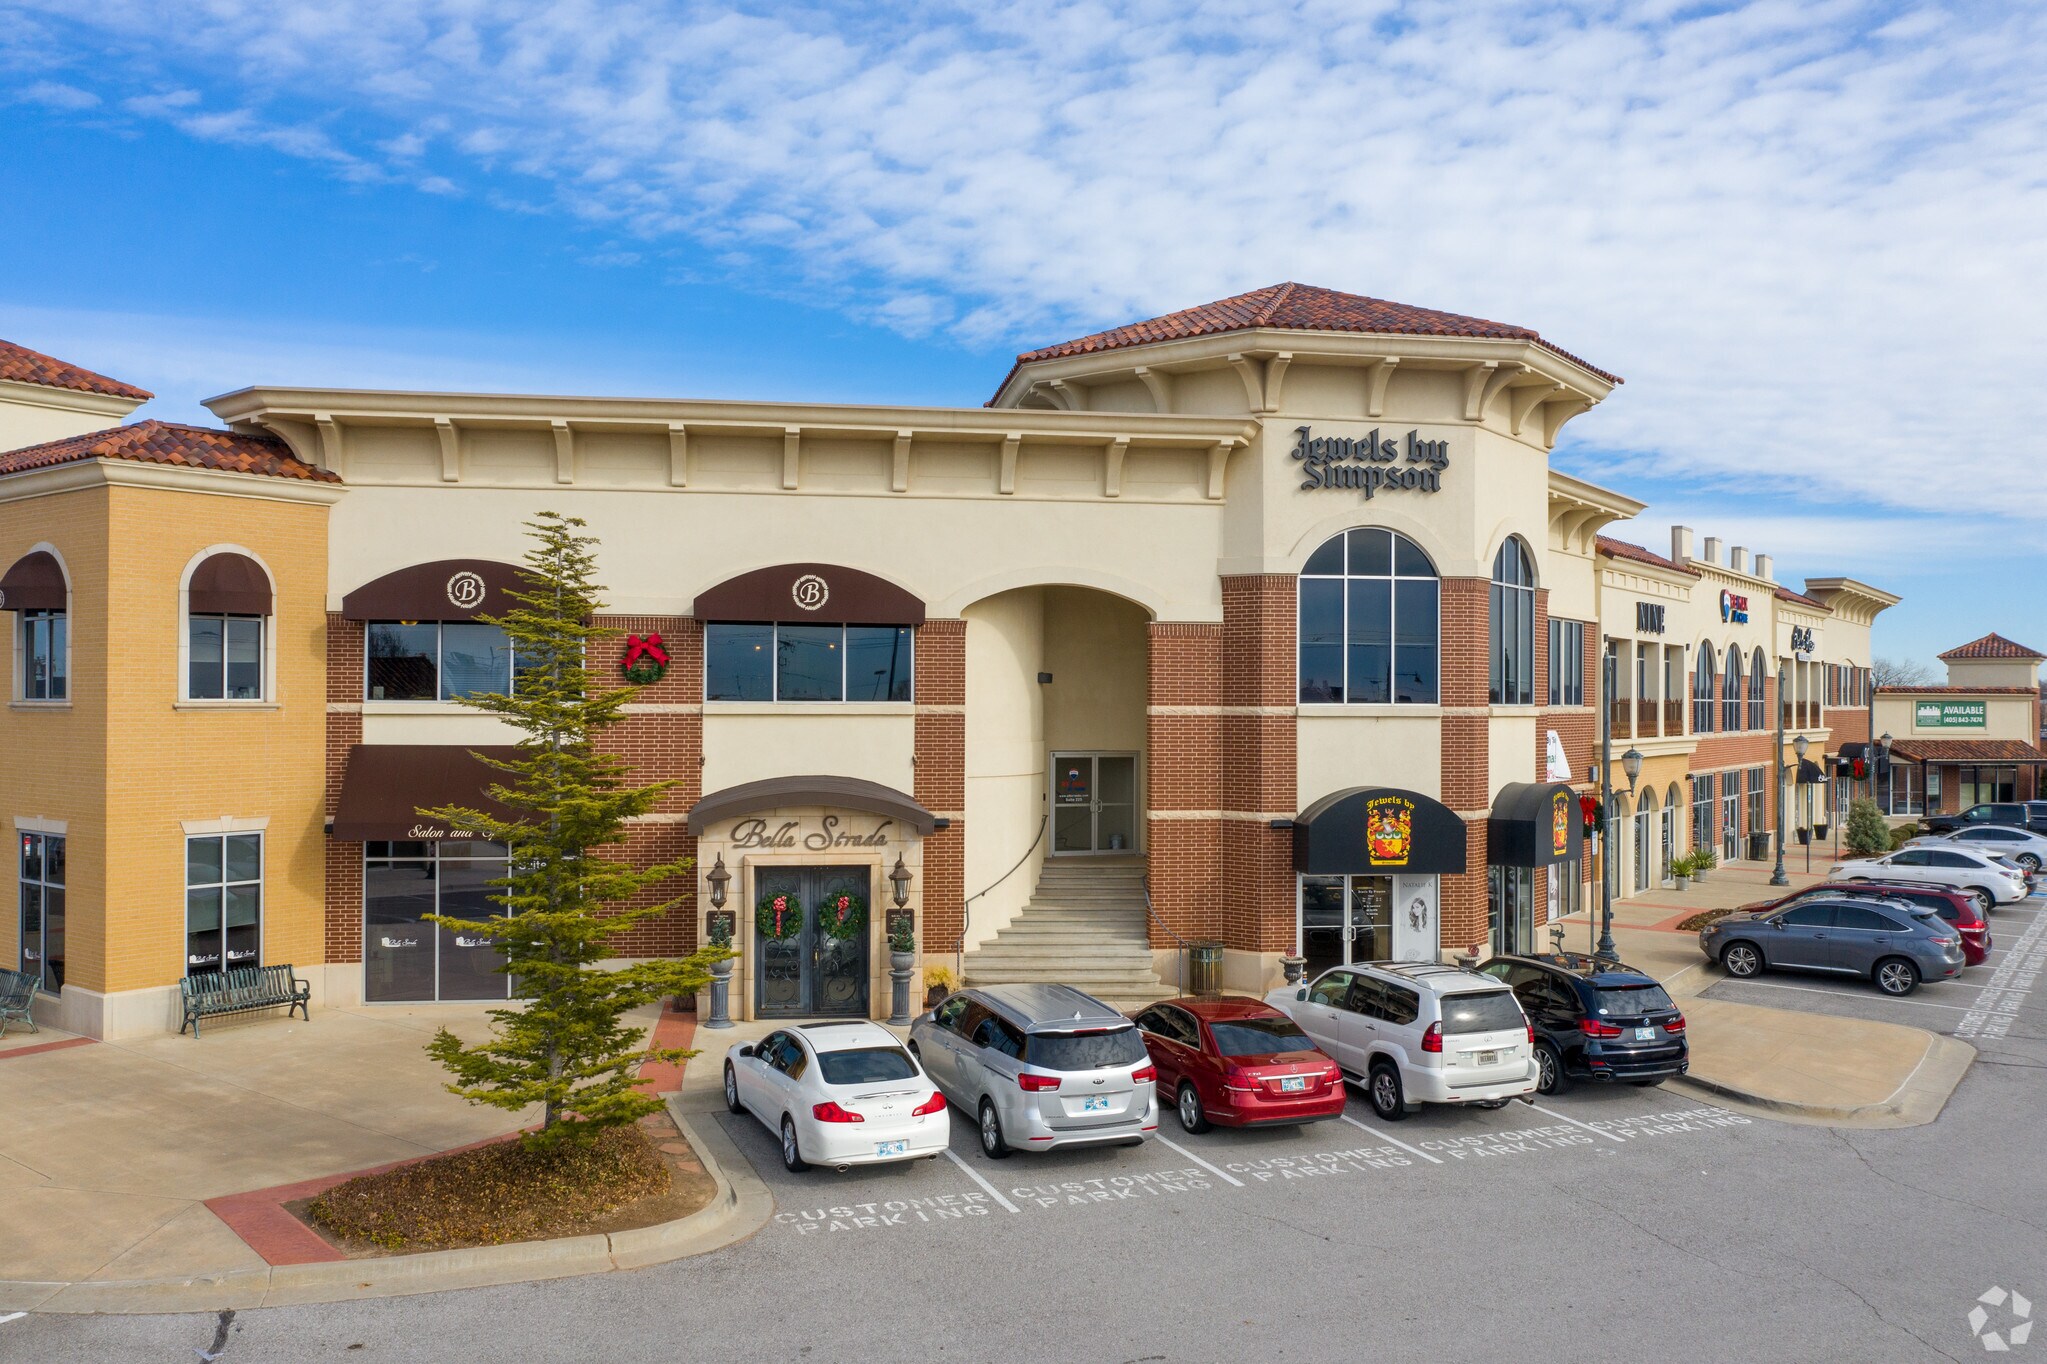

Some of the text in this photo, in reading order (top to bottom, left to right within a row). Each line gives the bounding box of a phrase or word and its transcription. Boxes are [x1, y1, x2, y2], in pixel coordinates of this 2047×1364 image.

[1291, 425, 1450, 471] Jewels by
[1301, 457, 1441, 500] Simpson
[455, 579, 476, 601] B
[800, 582, 820, 603] B
[1943, 706, 1984, 715] AVAILABLE
[1943, 716, 1958, 724] (405)
[1366, 796, 1402, 812] Jewels
[408, 824, 444, 838] Salon
[730, 815, 893, 850] Bella Strada
[1588, 1108, 1737, 1130] CUSTOMER
[1617, 1116, 1752, 1138] PARKING
[1419, 1125, 1582, 1150] CUSTOMER
[1448, 1134, 1594, 1160] PARKING
[1226, 1146, 1404, 1172] CUSTOMER
[1252, 1156, 1413, 1181] PARKING
[1011, 1168, 1208, 1198] CUSTOMER
[1035, 1179, 1212, 1208] PARKING
[774, 1192, 989, 1224] CUSTOMER
[795, 1205, 989, 1235] PARKING
